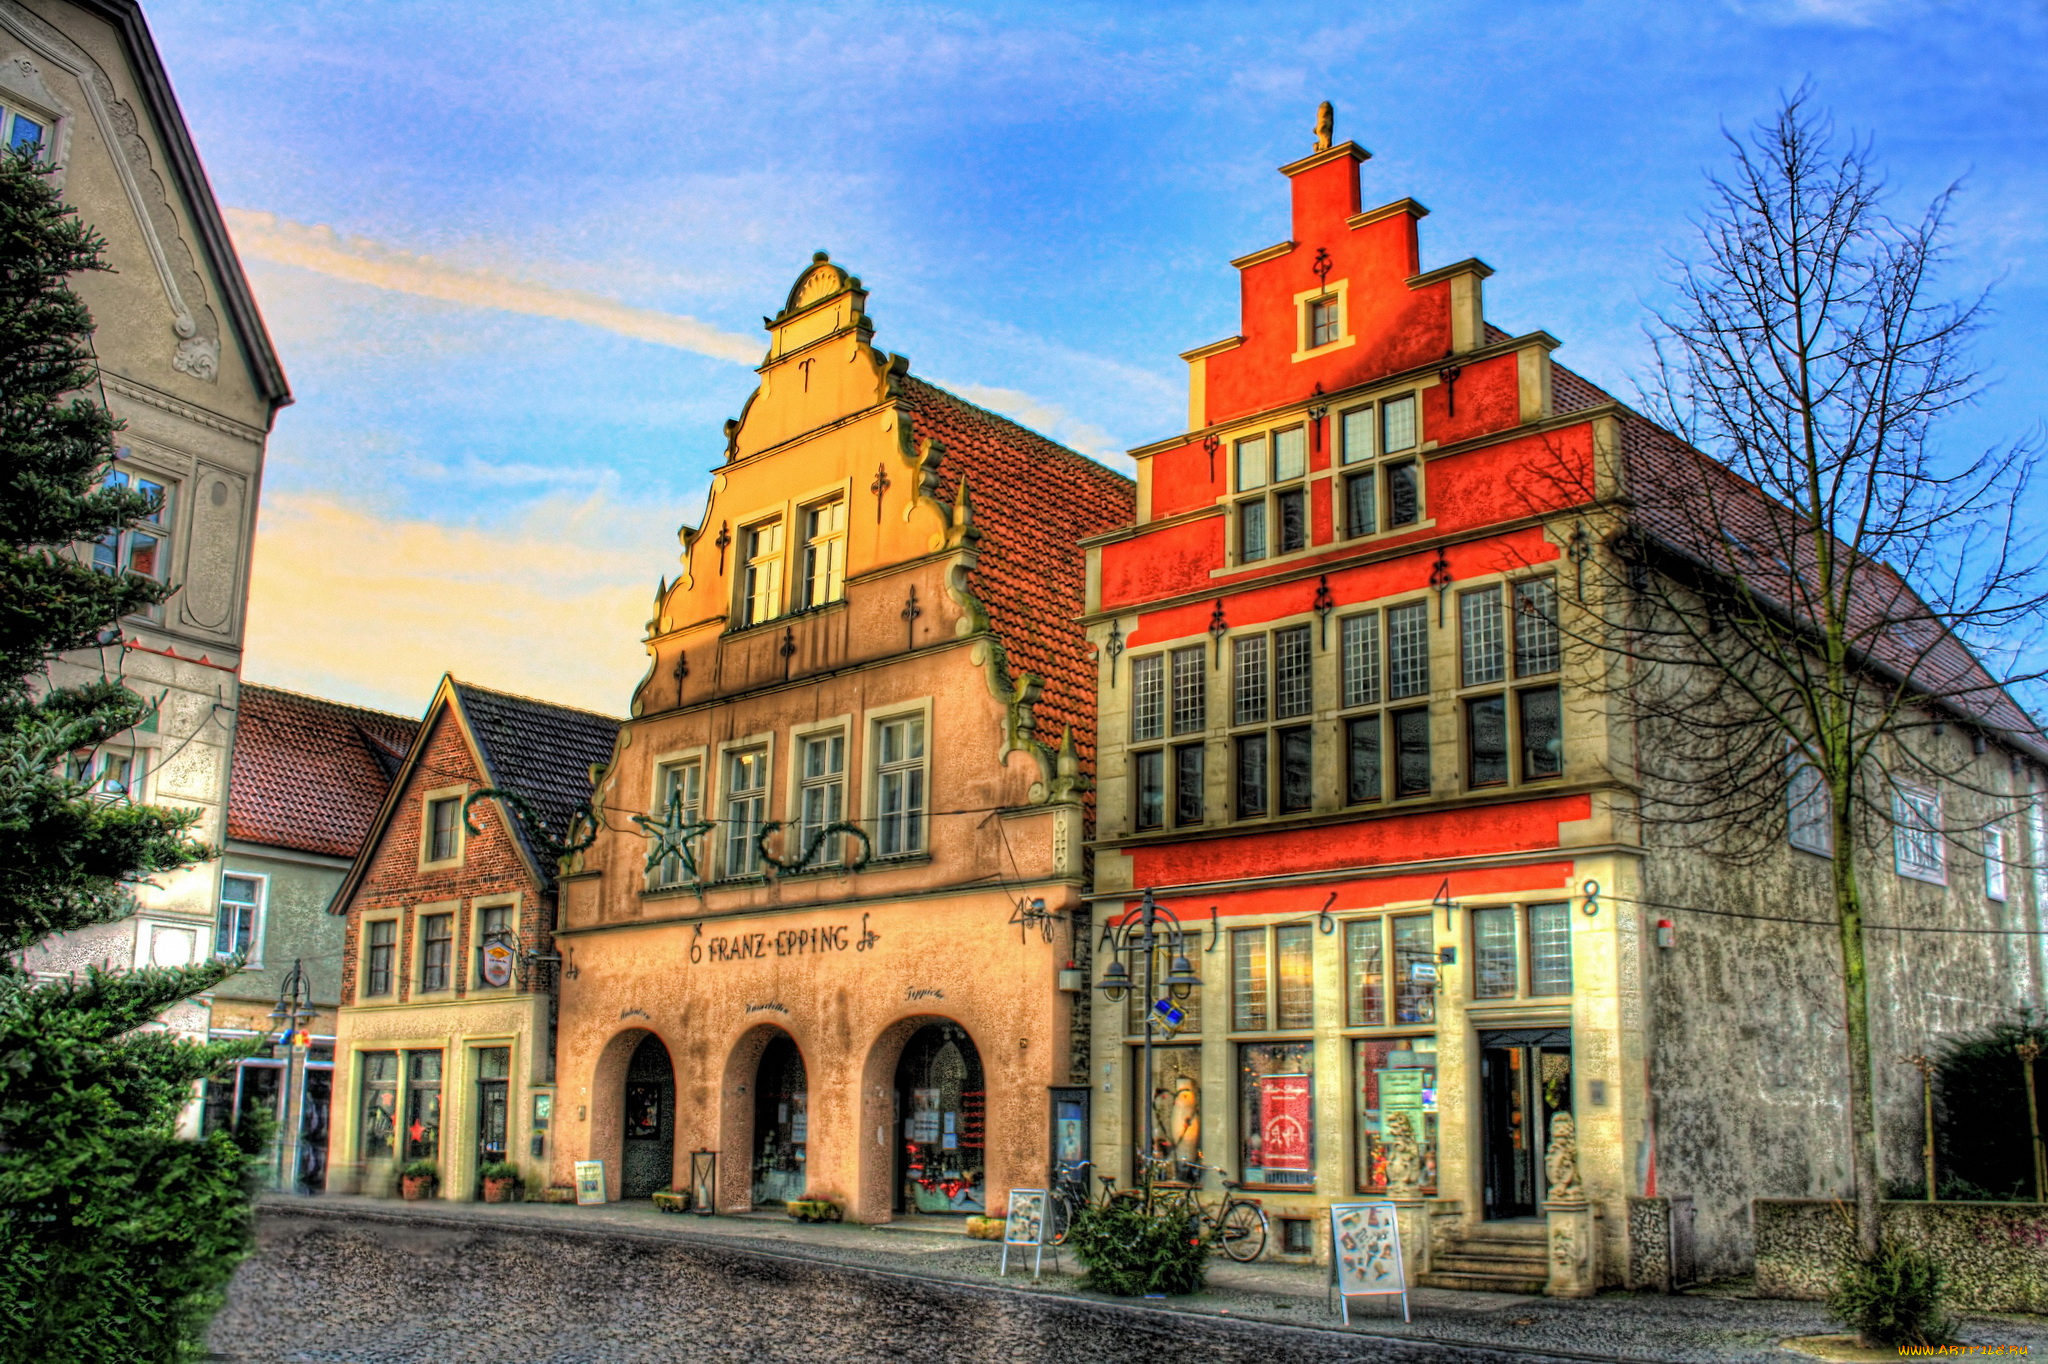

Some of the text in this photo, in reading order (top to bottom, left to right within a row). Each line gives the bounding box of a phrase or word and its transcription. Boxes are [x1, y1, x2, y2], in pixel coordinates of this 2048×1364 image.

[1432, 877, 1459, 931] 4
[1583, 879, 1600, 916] 8
[709, 925, 848, 962] FRANZ EPPING
